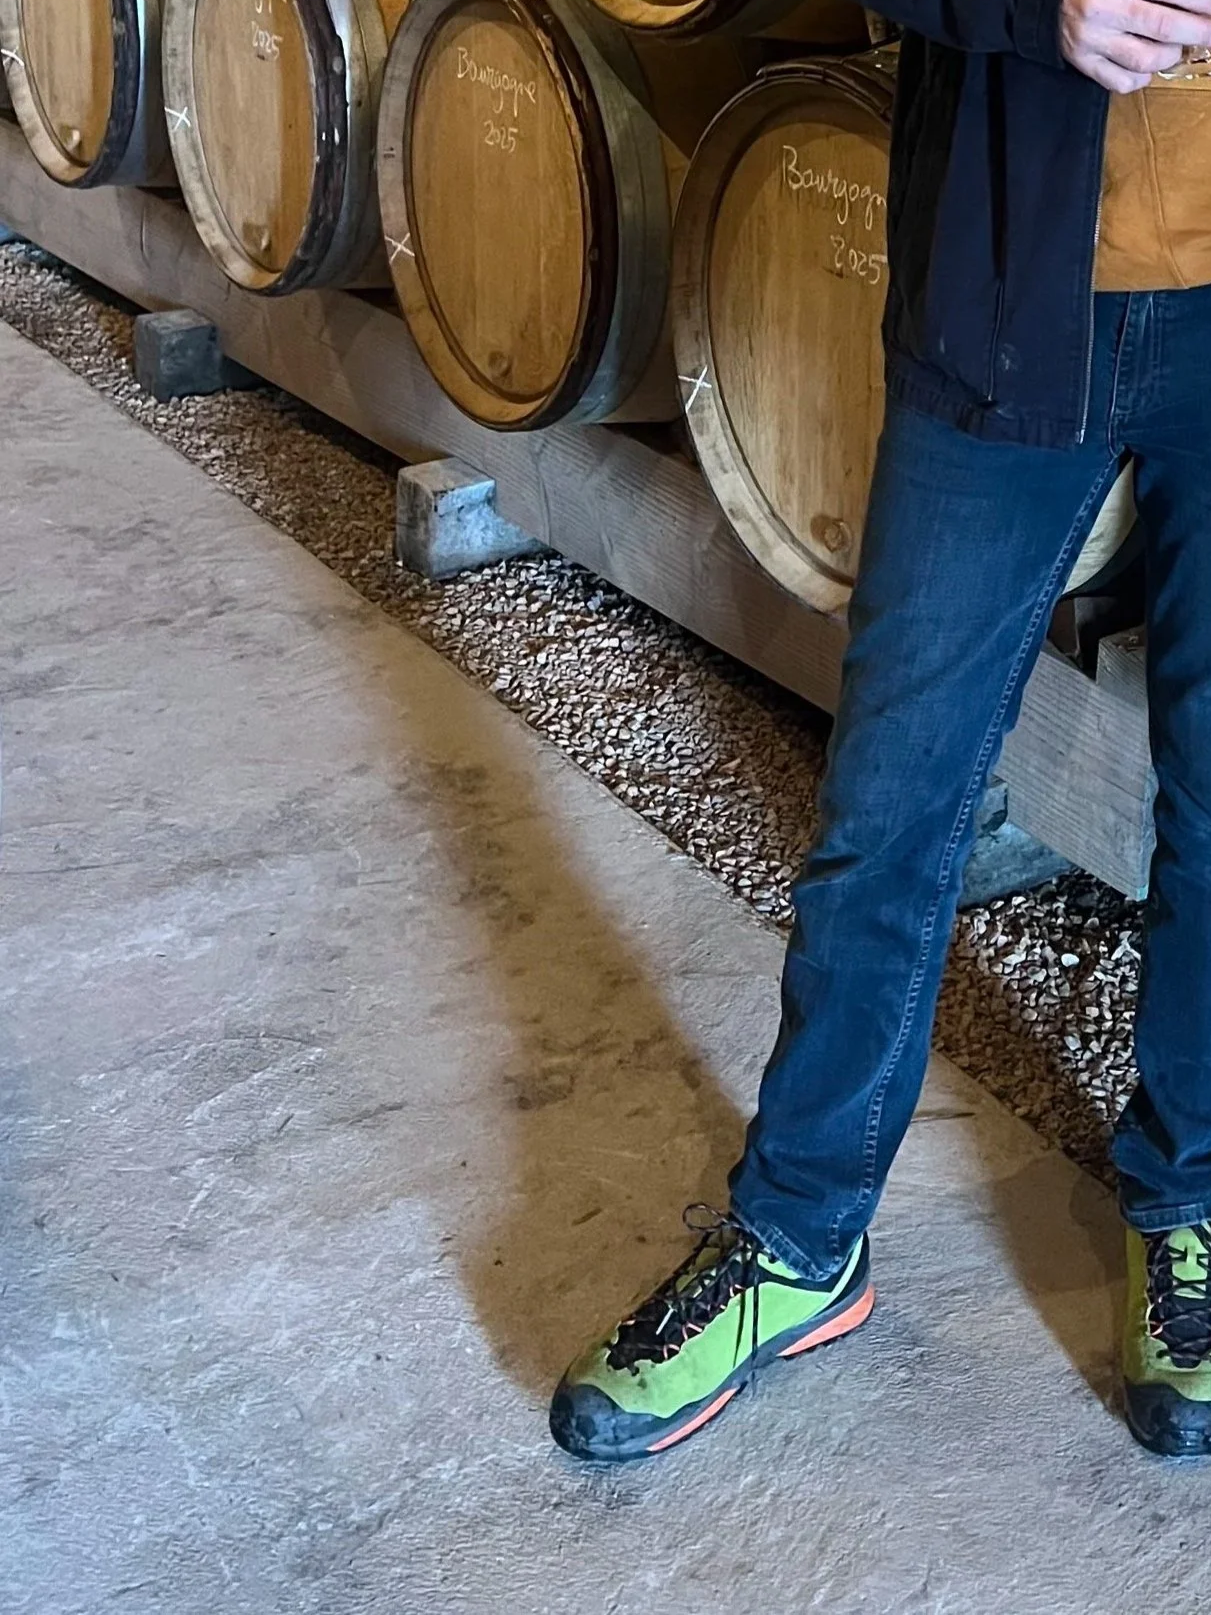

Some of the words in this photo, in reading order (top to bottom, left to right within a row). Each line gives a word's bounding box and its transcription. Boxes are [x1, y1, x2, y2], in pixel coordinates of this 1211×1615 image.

[457, 46, 537, 117] Bourgogne
[483, 119, 519, 154] 2025
[782, 144, 889, 231] Bourgogn
[830, 234, 889, 285] 2025
